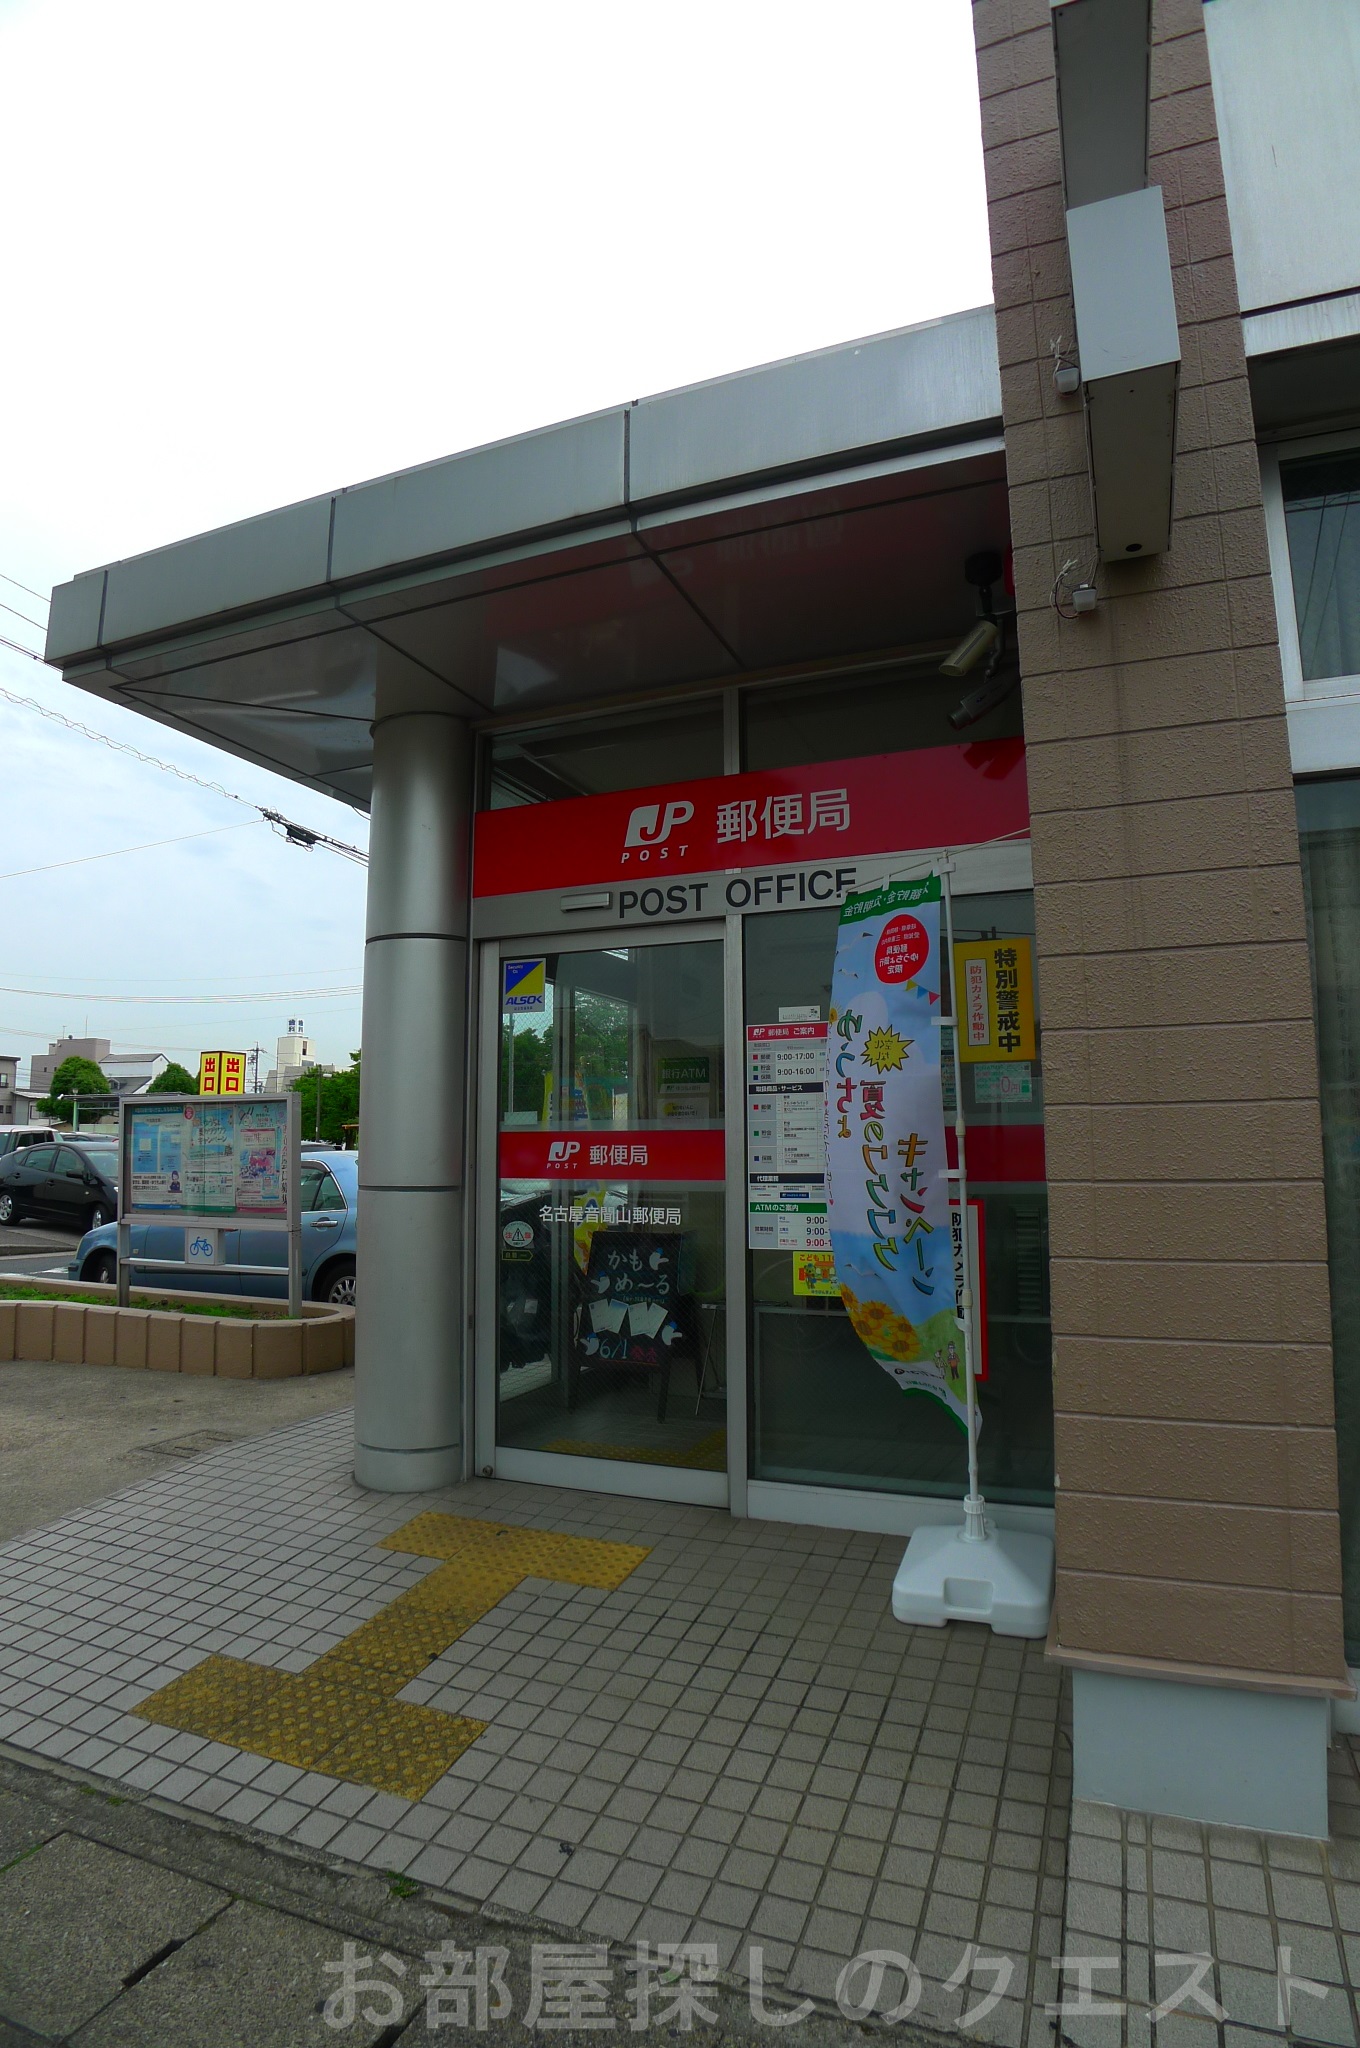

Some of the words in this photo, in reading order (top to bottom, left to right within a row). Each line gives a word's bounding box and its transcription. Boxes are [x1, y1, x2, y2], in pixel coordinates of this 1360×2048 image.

[717, 788, 851, 844] 郵便局
[620, 845, 689, 864] POST
[619, 883, 709, 919] POST
[725, 868, 859, 908] OFFICE
[505, 995, 543, 1006] ALSOK
[969, 965, 984, 1041] 防犯カメラ作動中
[994, 948, 1020, 1052] 特別警戒中
[794, 1027, 815, 1035] ご案内
[776, 1052, 815, 1061] 9:00-17:00
[204, 1057, 216, 1092] 出口
[226, 1057, 240, 1092] 出口
[662, 1068, 706, 1079] 銀行ATM
[777, 1068, 815, 1076] 9:00-16:00
[589, 1145, 649, 1166] 郵便局
[539, 1204, 682, 1226] 名古屋音聞山郵便局
[754, 1204, 799, 1212] ATMのご案内
[608, 1248, 643, 1272] かも
